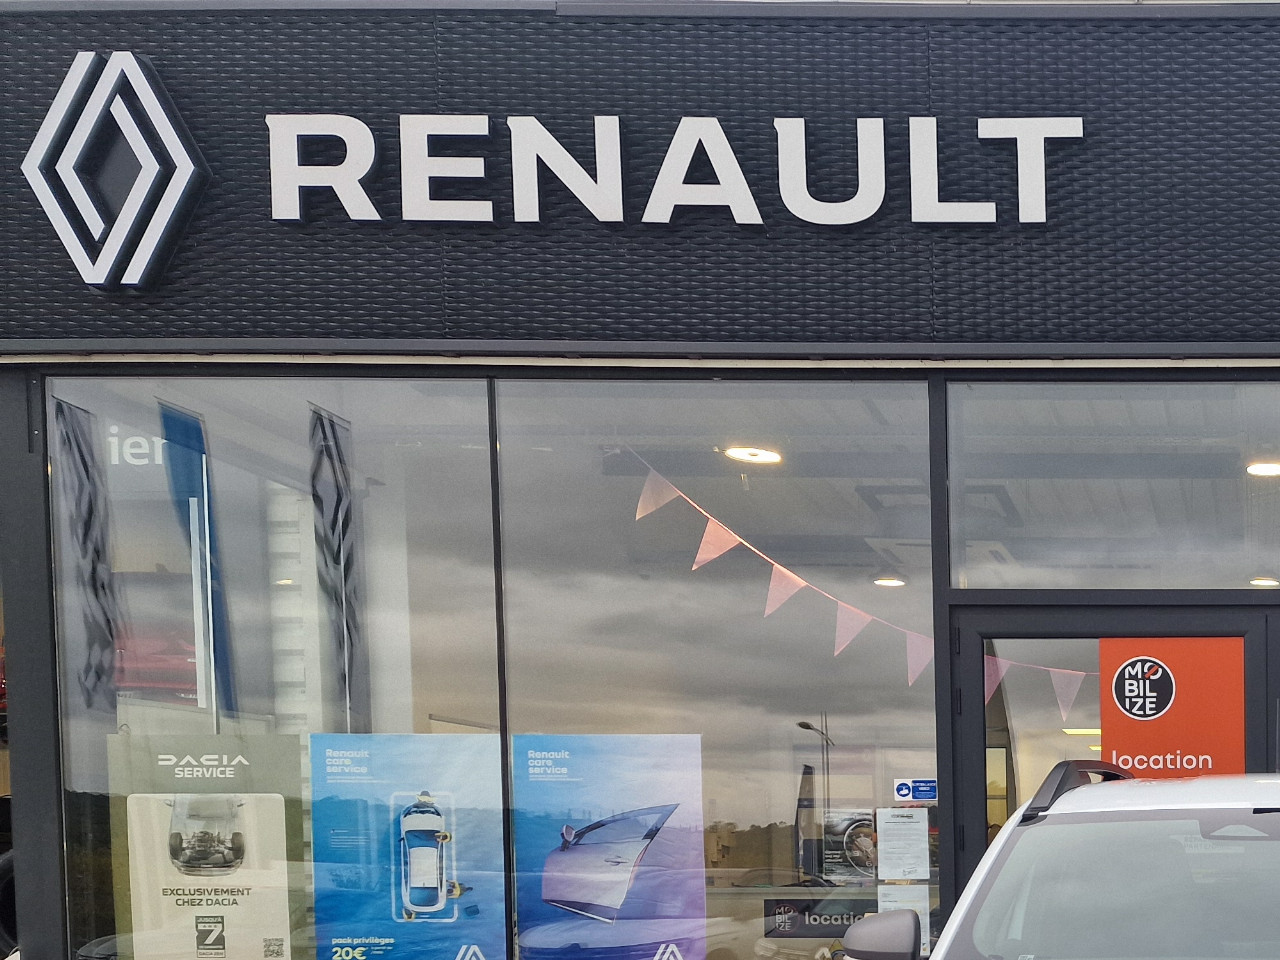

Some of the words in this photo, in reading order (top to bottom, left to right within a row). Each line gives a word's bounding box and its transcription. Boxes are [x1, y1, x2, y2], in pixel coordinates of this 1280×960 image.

[264, 113, 1084, 225] RENAULT
[326, 749, 369, 758] Renault
[528, 749, 570, 759] Renault
[158, 754, 250, 766] DACIA
[1112, 750, 1213, 769] location
[174, 767, 235, 778] SERVICE
[326, 765, 368, 773] service
[528, 766, 568, 774] service
[162, 887, 252, 896] EXCLUSIVEMENT
[175, 898, 204, 907] CHEZ
[205, 898, 239, 907] DACIA
[198, 923, 223, 945] 7
